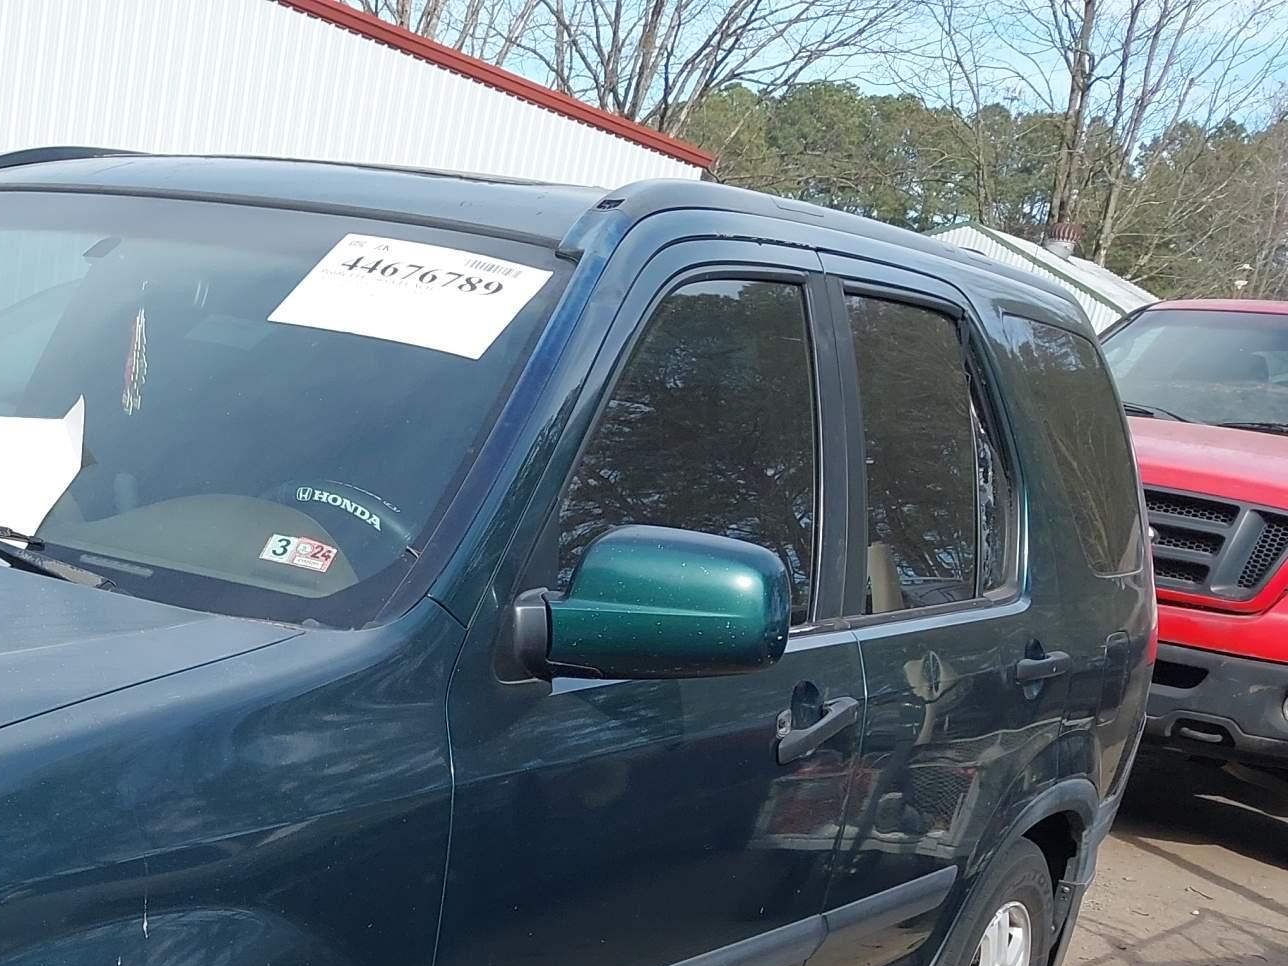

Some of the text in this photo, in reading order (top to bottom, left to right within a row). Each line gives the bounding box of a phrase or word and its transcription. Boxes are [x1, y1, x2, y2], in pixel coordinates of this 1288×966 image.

[340, 256, 504, 296] 44676789
[312, 489, 382, 531] HONDA
[272, 538, 291, 556] 3
